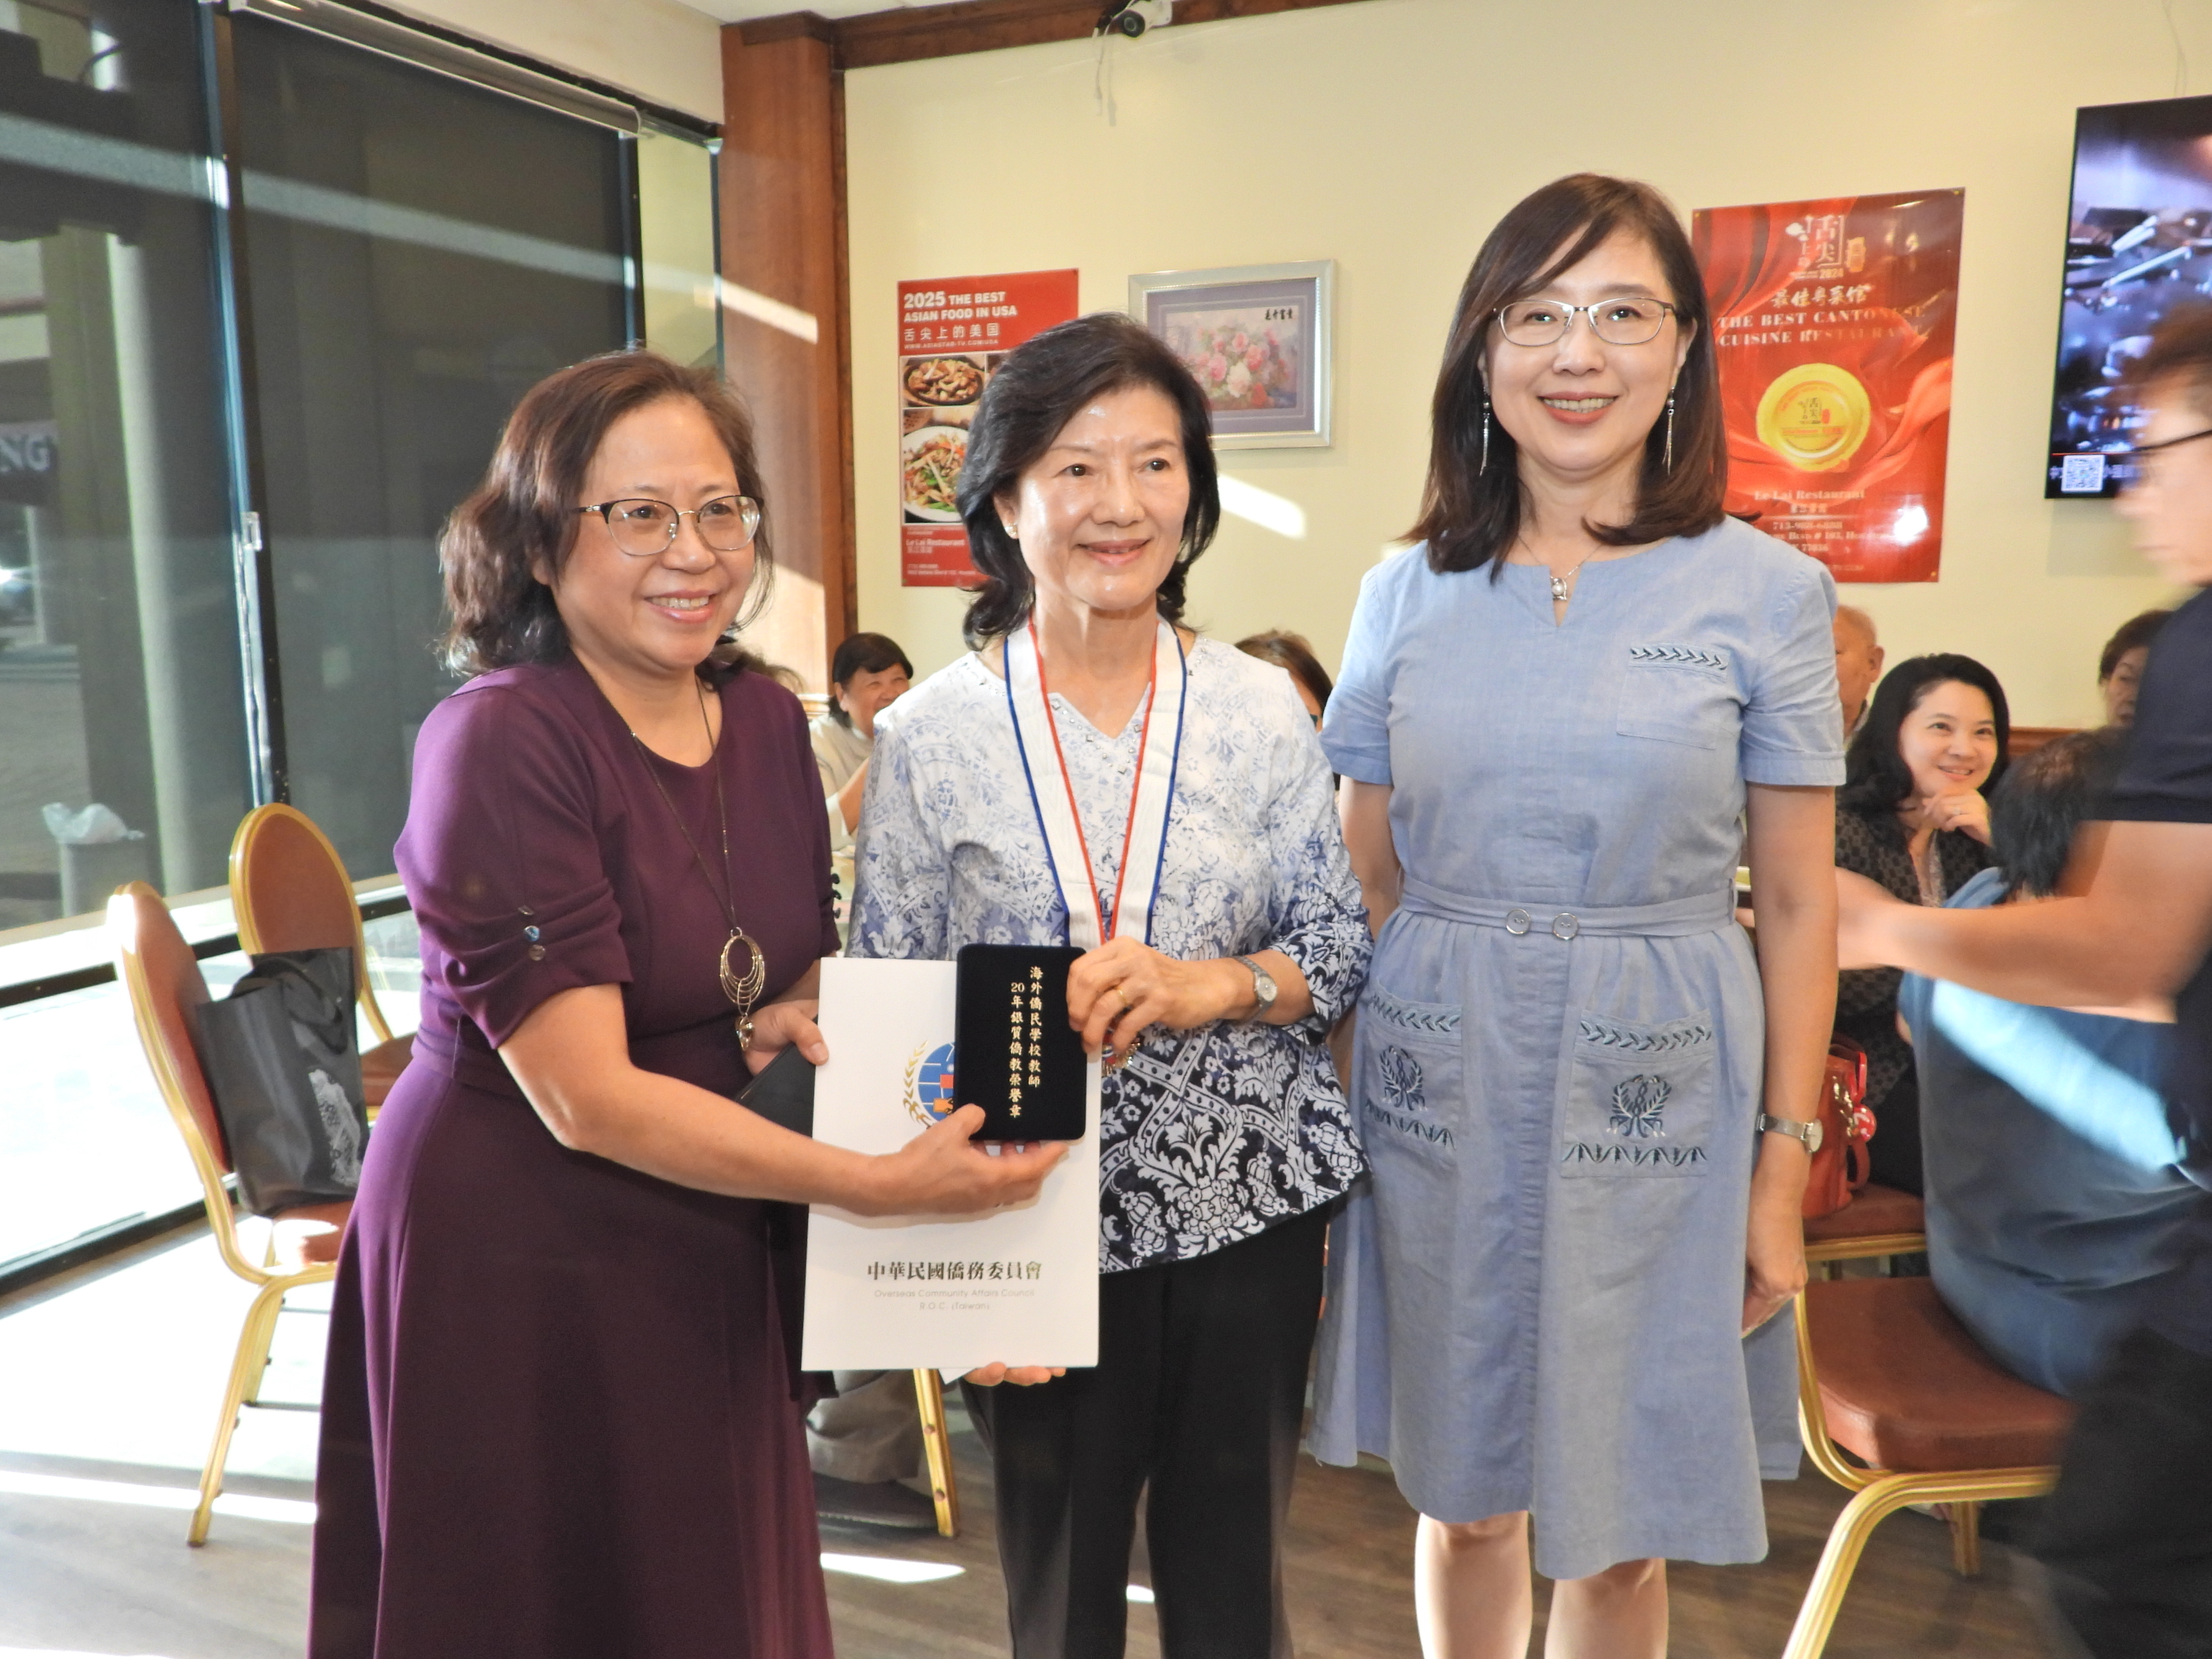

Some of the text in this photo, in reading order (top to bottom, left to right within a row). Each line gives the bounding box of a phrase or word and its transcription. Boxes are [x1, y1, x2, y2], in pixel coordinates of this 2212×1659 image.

[903, 290, 1006, 310] 2025 THE BEST
[903, 305, 1018, 323] ASIAN FOOD IN USA
[1717, 314, 1753, 329] THE
[1760, 312, 1807, 327] BEST
[904, 322, 1000, 342] 舌尖上的美国
[1719, 331, 1793, 347] CUISINE
[1797, 490, 1865, 500] Restaurant
[1028, 966, 1044, 1088] 海外僑民學校教師
[1008, 983, 1025, 1118] 20年銀質僑教榮譽章
[867, 1261, 1042, 1281] 中華民國僑務委員會
[874, 1288, 1035, 1299] Overseas Community Affairs Council
